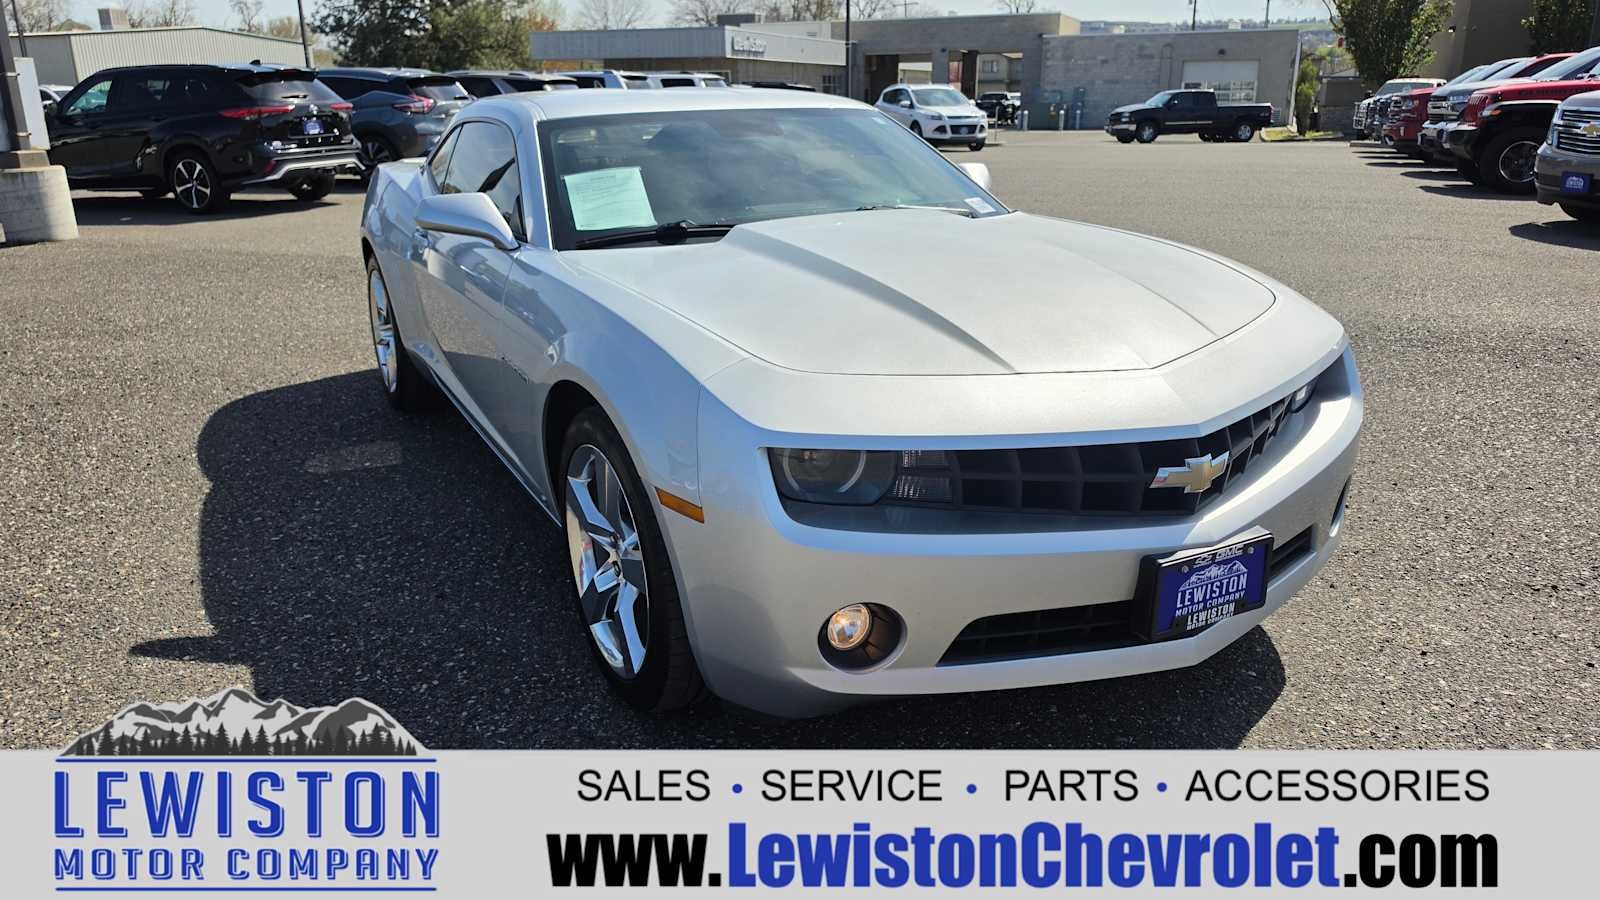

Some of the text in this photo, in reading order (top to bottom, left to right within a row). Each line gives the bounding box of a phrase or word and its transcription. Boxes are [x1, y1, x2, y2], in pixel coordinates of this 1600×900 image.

[1215, 544, 1245, 559] GMC
[1176, 573, 1248, 608] LEWISTON
[1175, 590, 1246, 617] MOTOR COMPANY
[1187, 602, 1236, 625] LEWISTON
